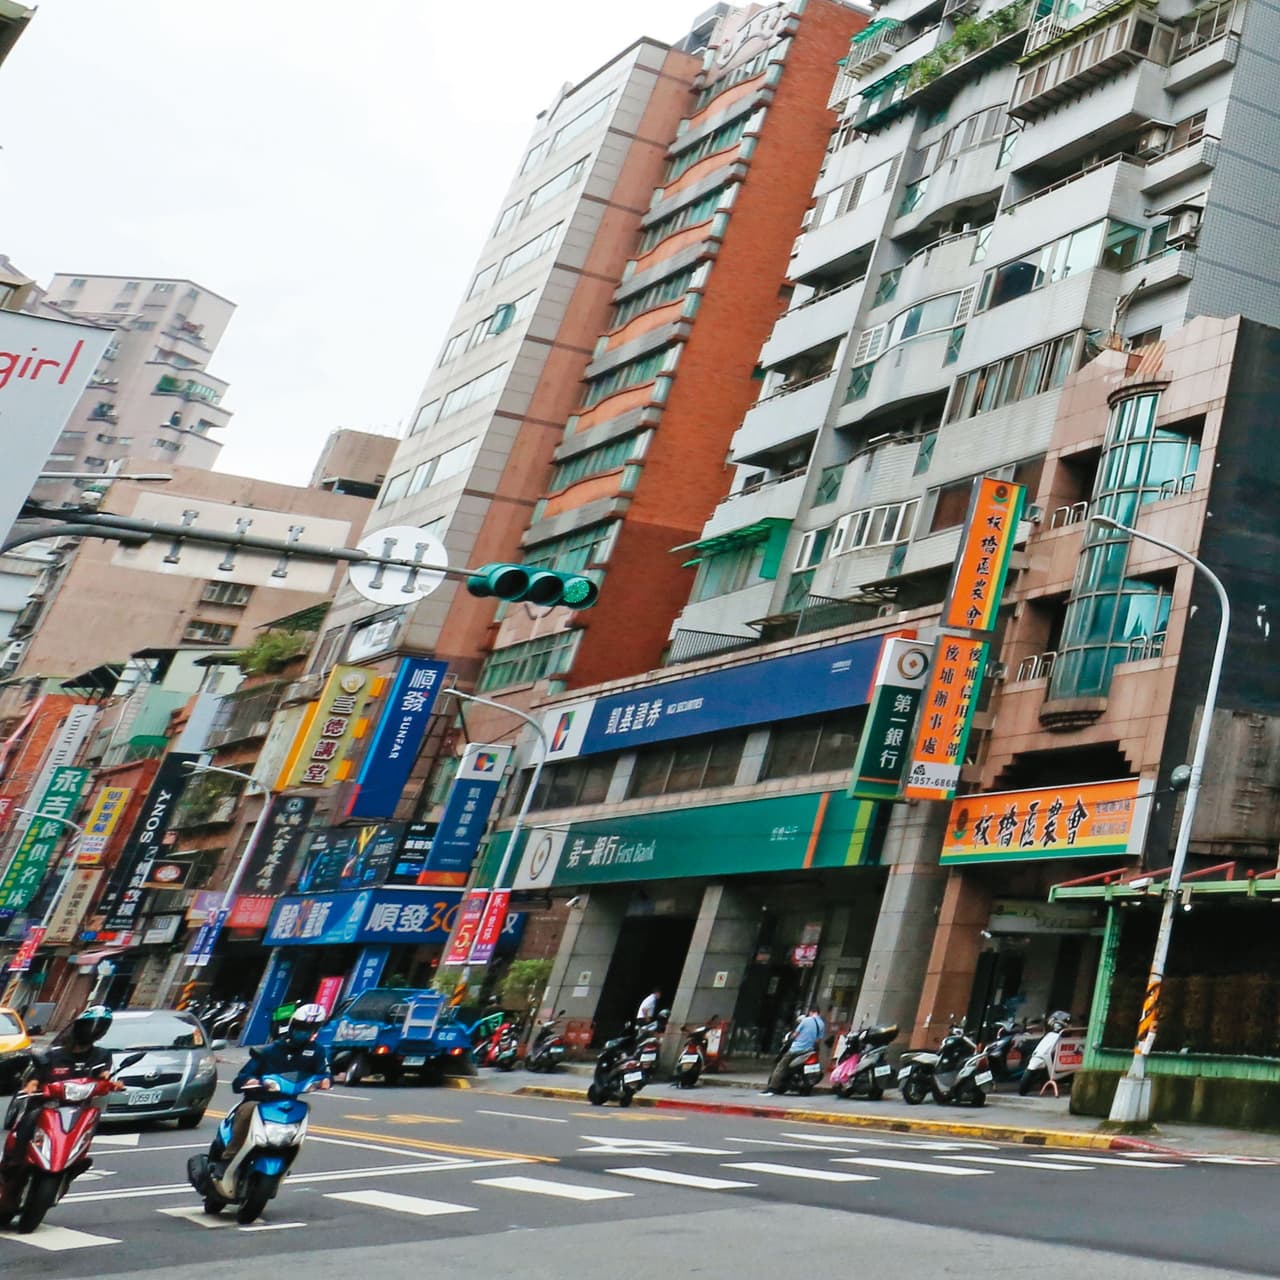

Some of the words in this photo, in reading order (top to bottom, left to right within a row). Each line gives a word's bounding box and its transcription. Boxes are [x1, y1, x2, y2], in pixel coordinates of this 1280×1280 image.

[966, 514, 1003, 625] 板橋區農會
[401, 668, 438, 712] 順發
[604, 699, 663, 734] 凱基證券
[921, 644, 959, 754] 後埔辦事處
[879, 693, 912, 770] 第一銀行
[140, 790, 172, 843] SONY
[974, 794, 1088, 849] 板橋區農會
[566, 835, 621, 868] 第一銀行
[454, 924, 473, 948] 5
